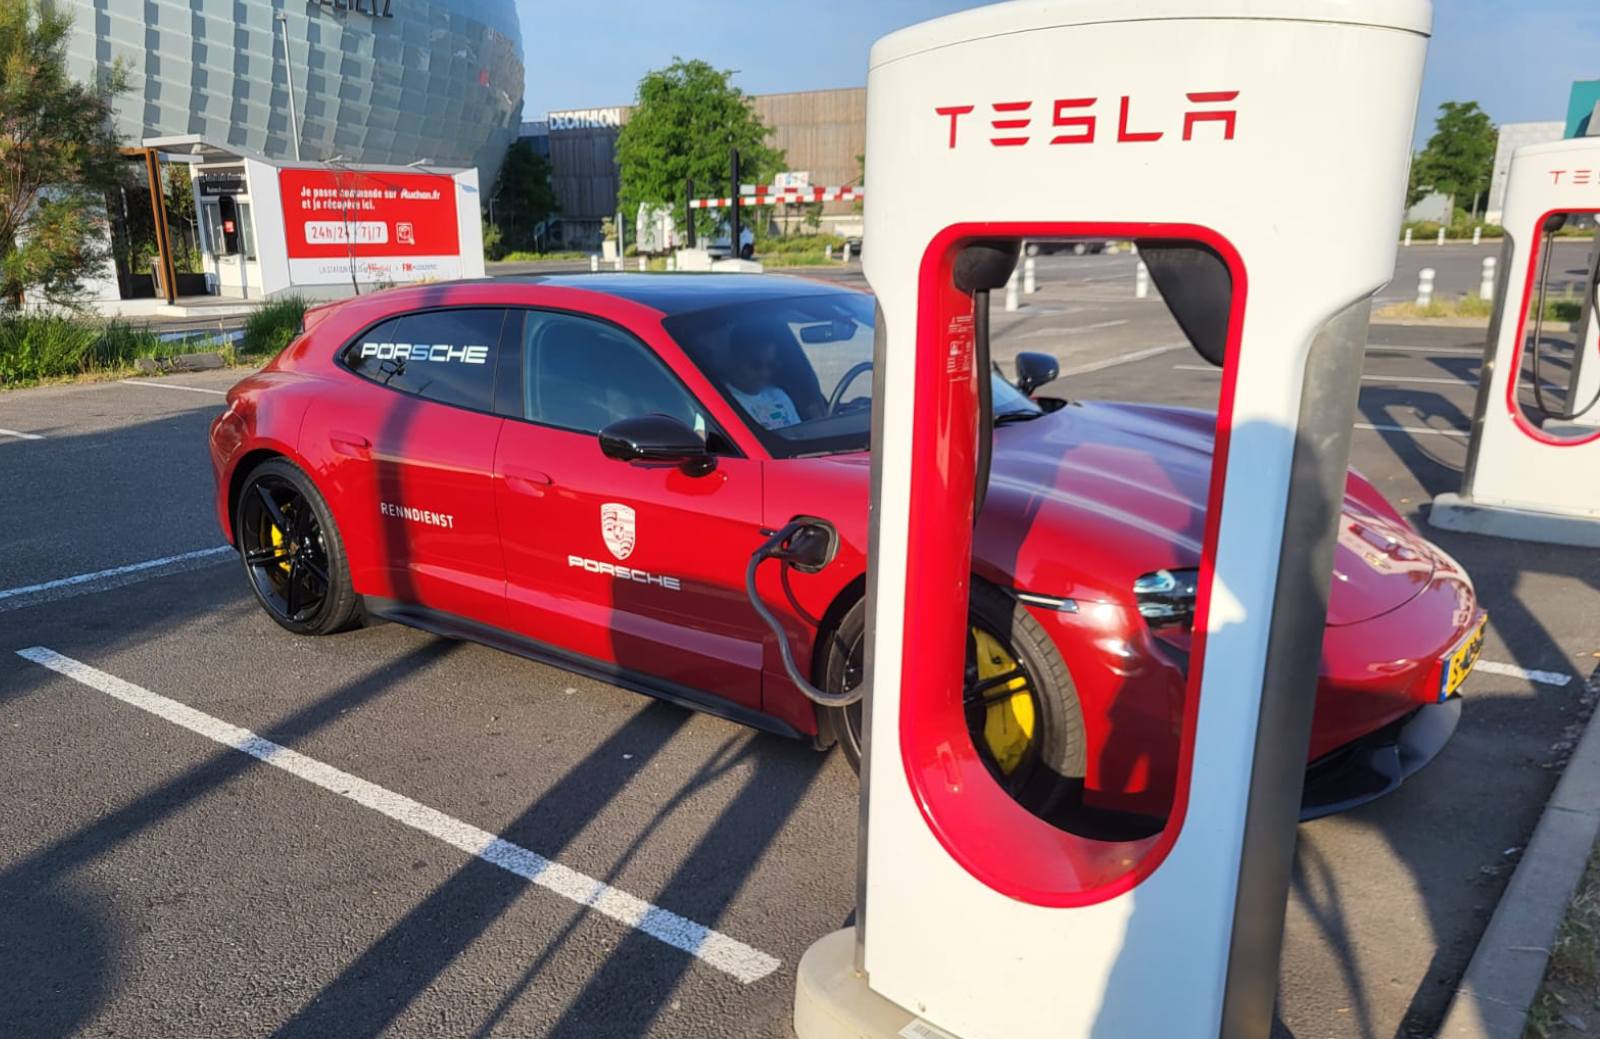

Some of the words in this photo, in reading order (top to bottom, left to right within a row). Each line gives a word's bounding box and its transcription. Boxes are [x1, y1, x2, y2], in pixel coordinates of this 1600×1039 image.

[549, 108, 621, 130] DECATHLON
[934, 90, 1240, 149] TESLA
[1548, 169, 1600, 185] TE
[300, 185, 312, 197] Je
[313, 187, 338, 201] passe
[384, 189, 397, 199] sur
[400, 188, 440, 200] Auchan.fr
[301, 199, 311, 209] et
[312, 198, 321, 211] je
[360, 342, 489, 364] PORSCHE
[380, 502, 453, 529] RENNDIENST
[567, 554, 681, 591] PORSCHE
